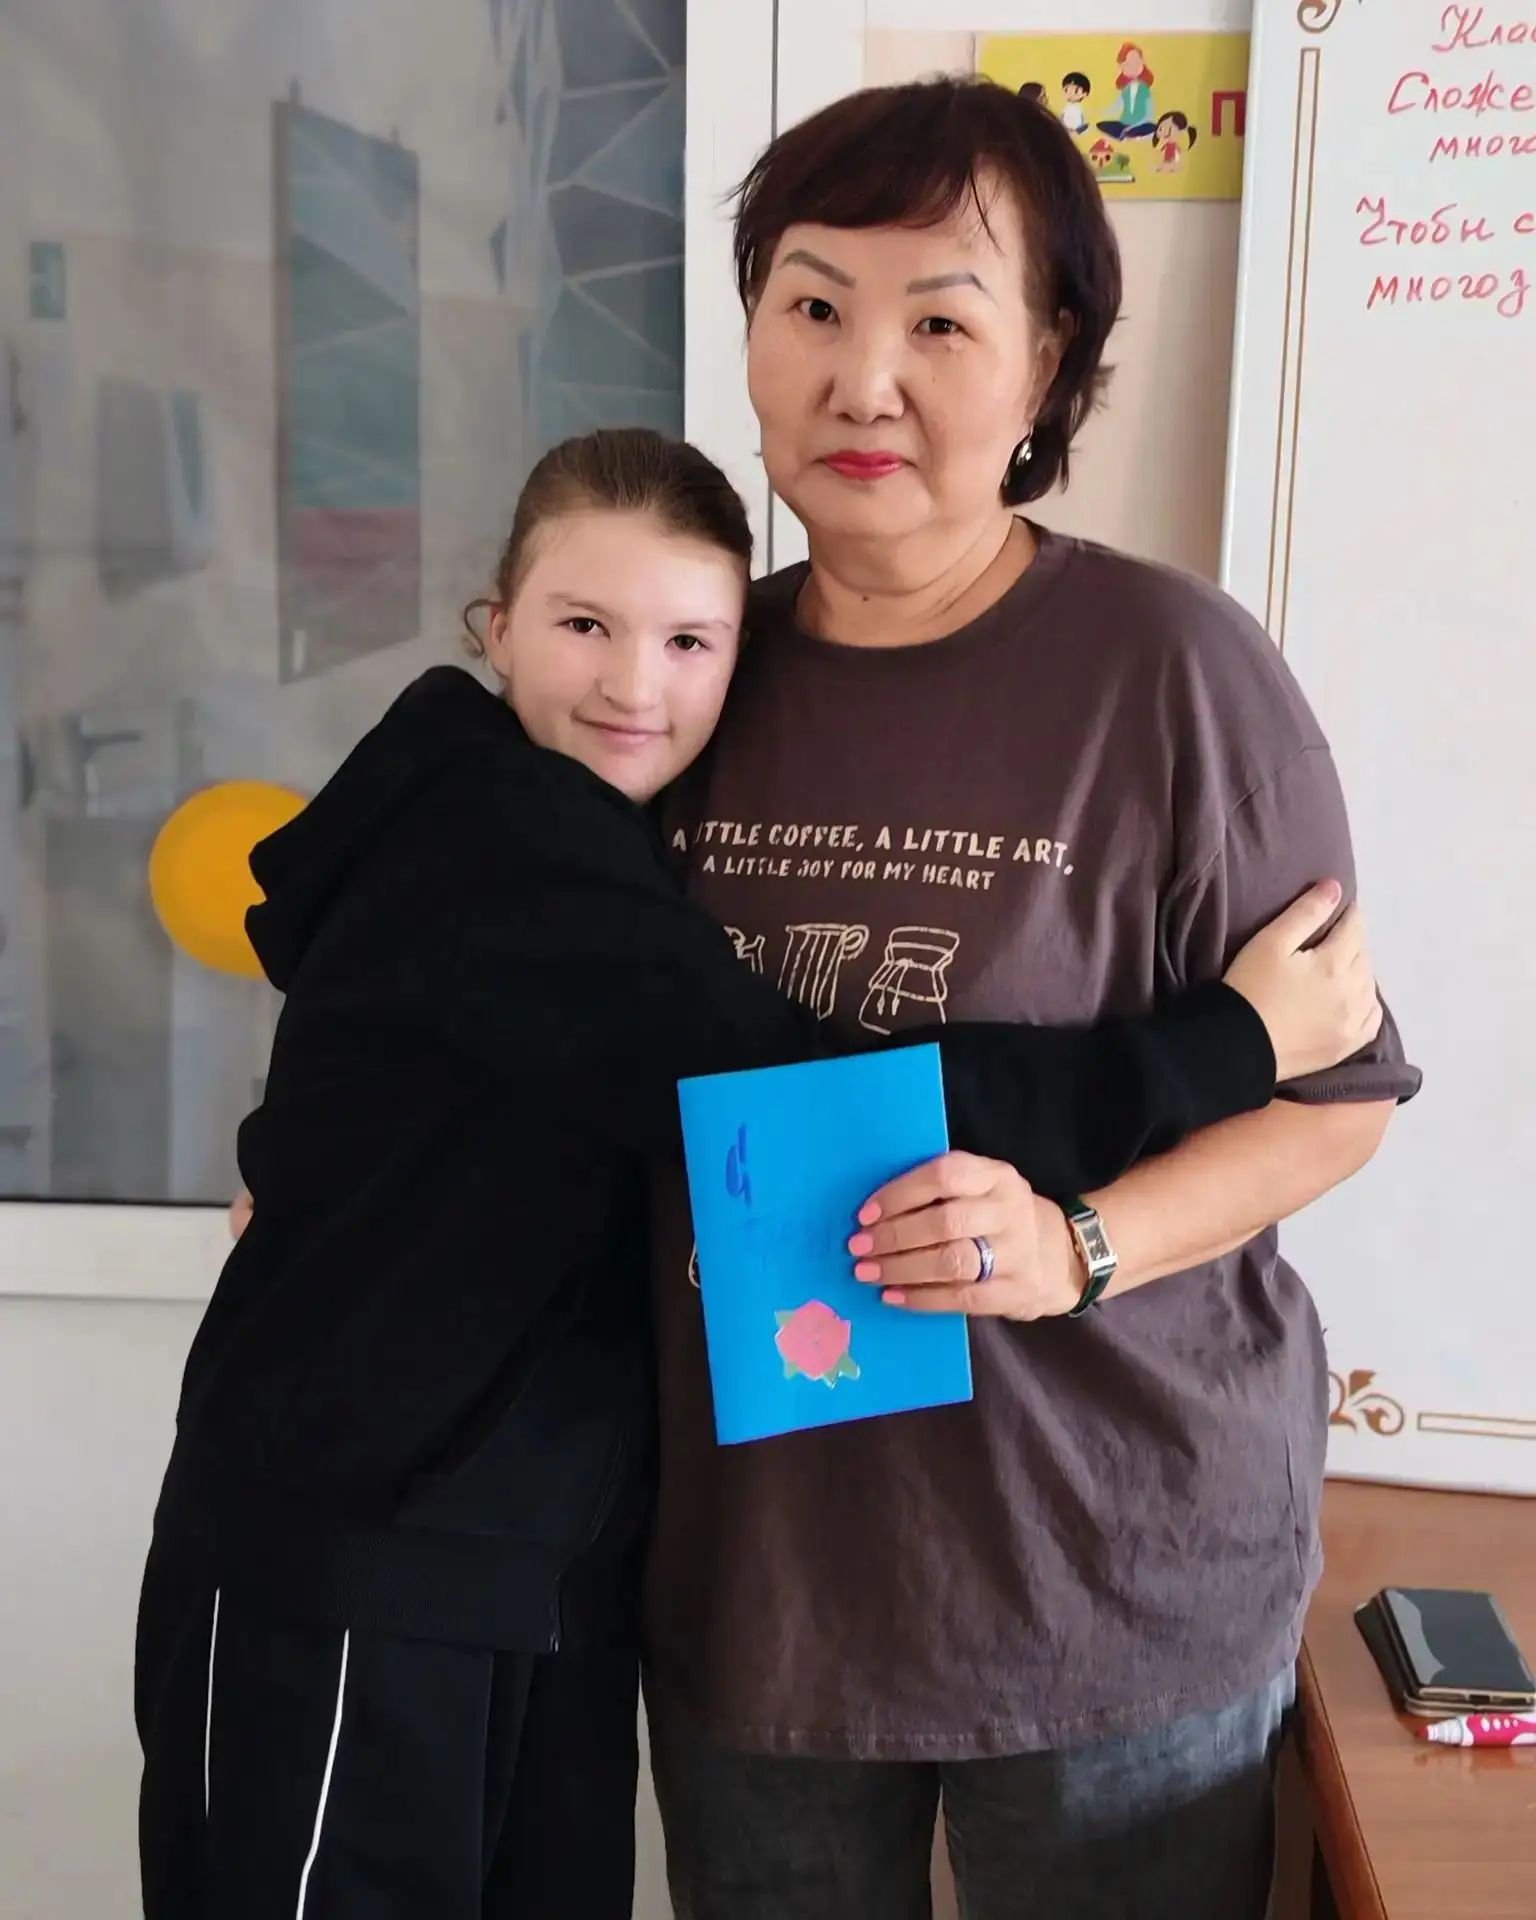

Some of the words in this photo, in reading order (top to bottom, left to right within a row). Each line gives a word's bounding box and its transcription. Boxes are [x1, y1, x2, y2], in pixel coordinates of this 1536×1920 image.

[671, 828, 687, 852] A
[767, 823, 864, 852] COFFEE,
[874, 825, 891, 850] A
[903, 827, 1004, 860] LITTLE
[702, 854, 716, 873] A
[723, 855, 792, 877] LITTLE
[840, 860, 876, 880] FOR
[882, 861, 916, 881] MY
[922, 863, 995, 890] HEART
